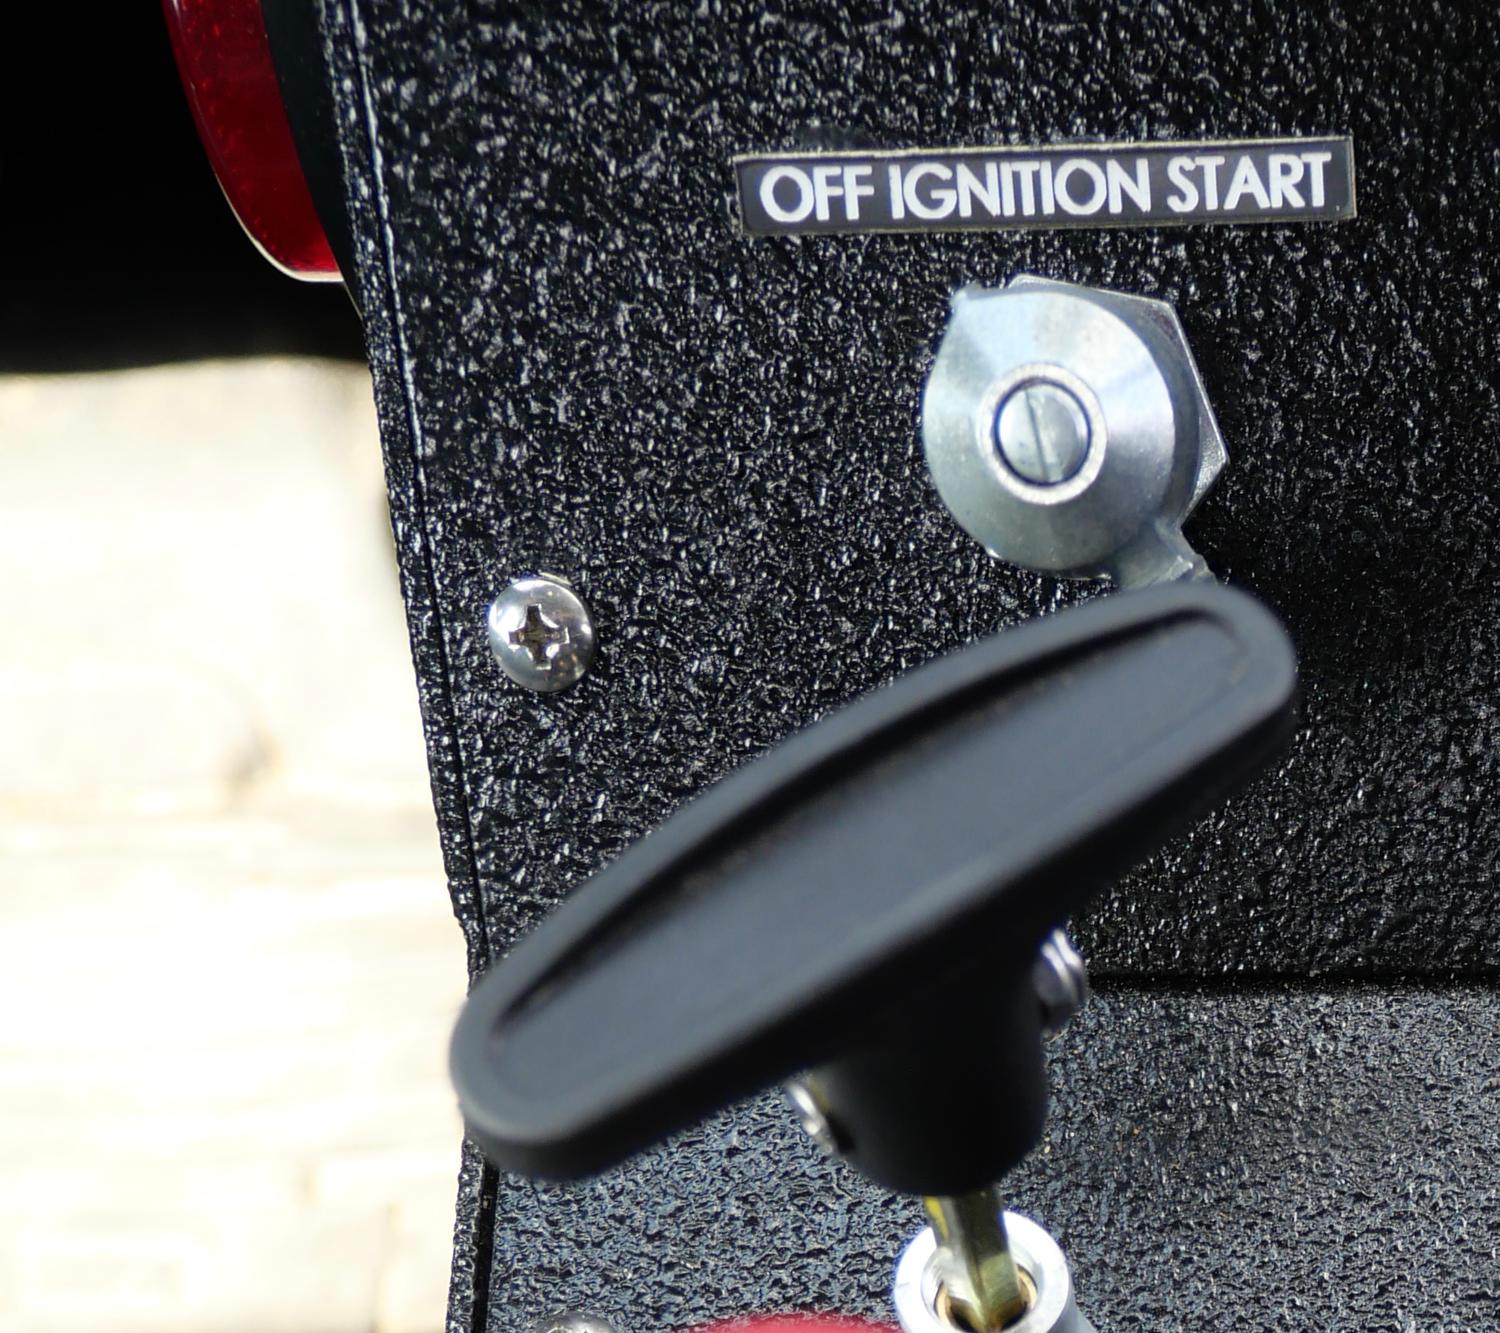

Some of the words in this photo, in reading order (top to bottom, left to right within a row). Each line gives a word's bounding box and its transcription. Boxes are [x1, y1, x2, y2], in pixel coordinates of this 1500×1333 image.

[759, 165, 874, 222] OFF
[890, 156, 1150, 219] IGNITION
[1167, 152, 1331, 213] START
